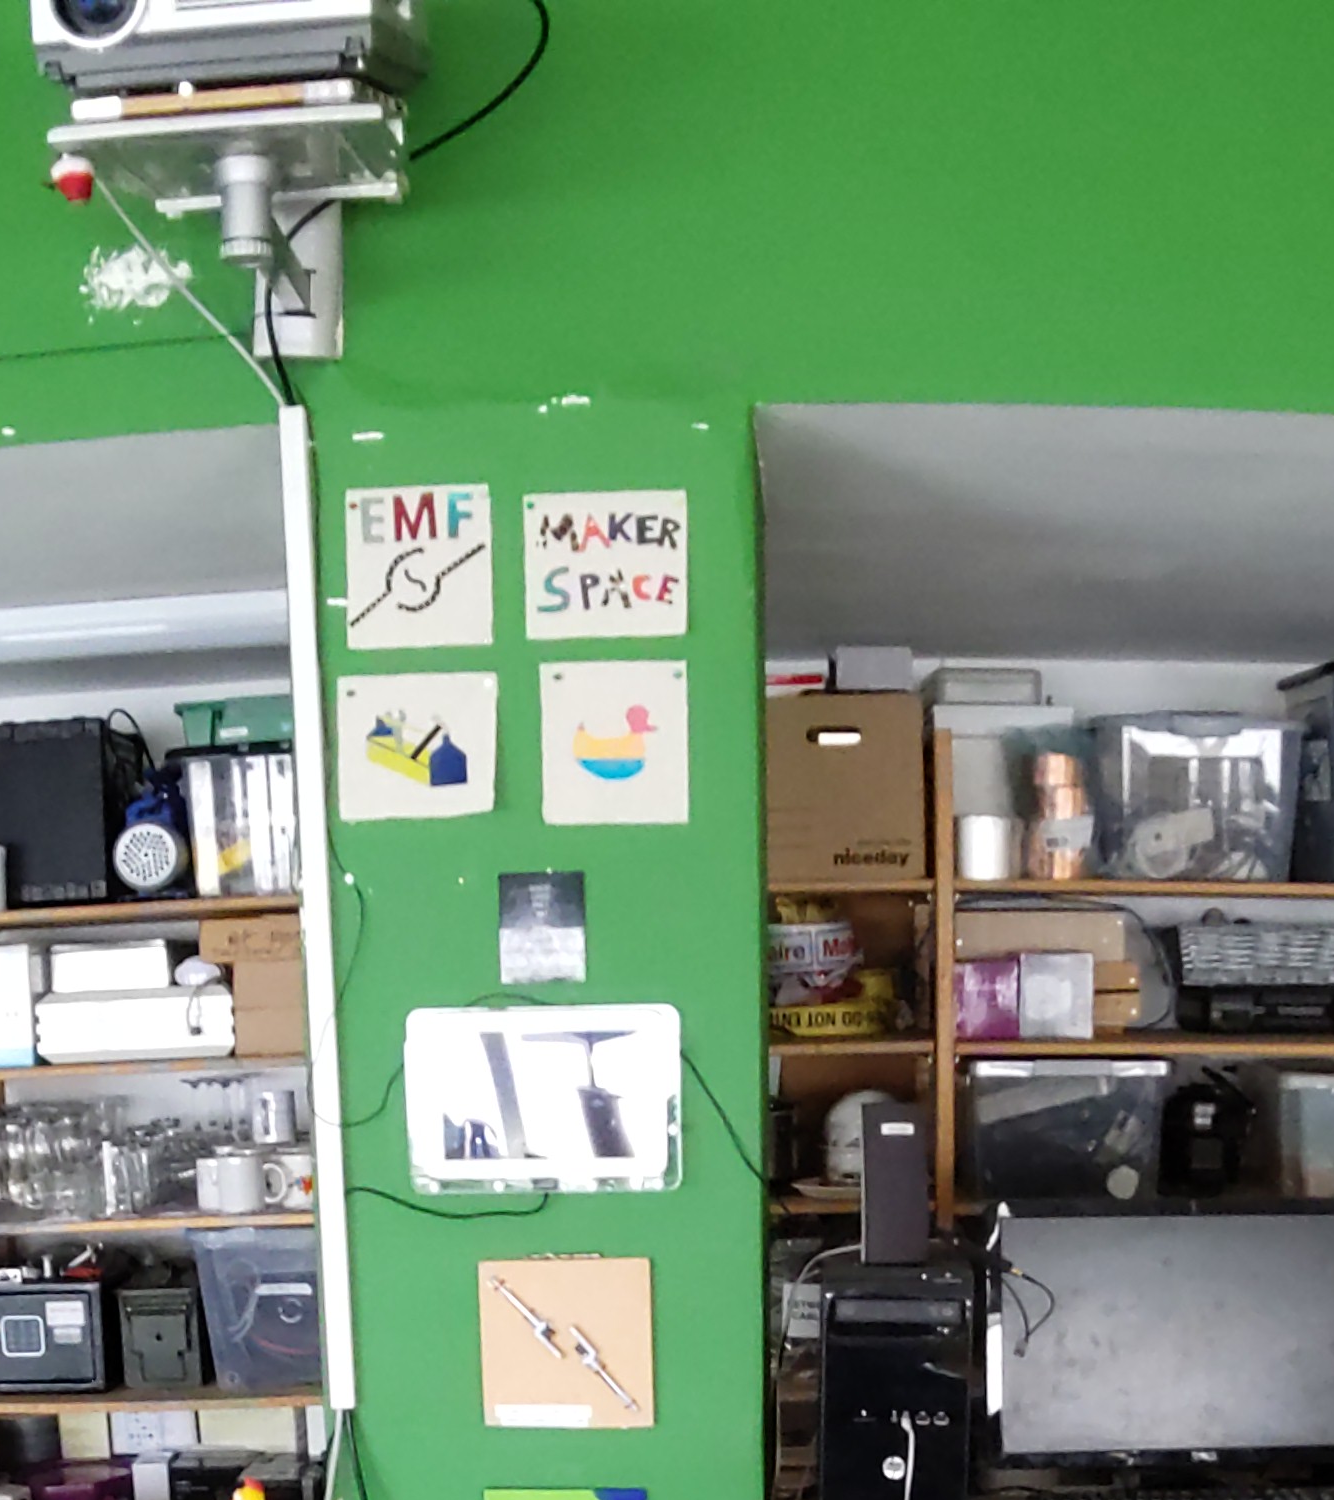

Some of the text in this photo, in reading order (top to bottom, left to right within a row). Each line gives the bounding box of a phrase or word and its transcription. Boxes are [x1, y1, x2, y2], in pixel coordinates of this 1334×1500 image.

[360, 492, 474, 545] EMF
[536, 512, 681, 553] MAKER
[537, 566, 680, 613] SPACE
[833, 847, 910, 868] niceday
